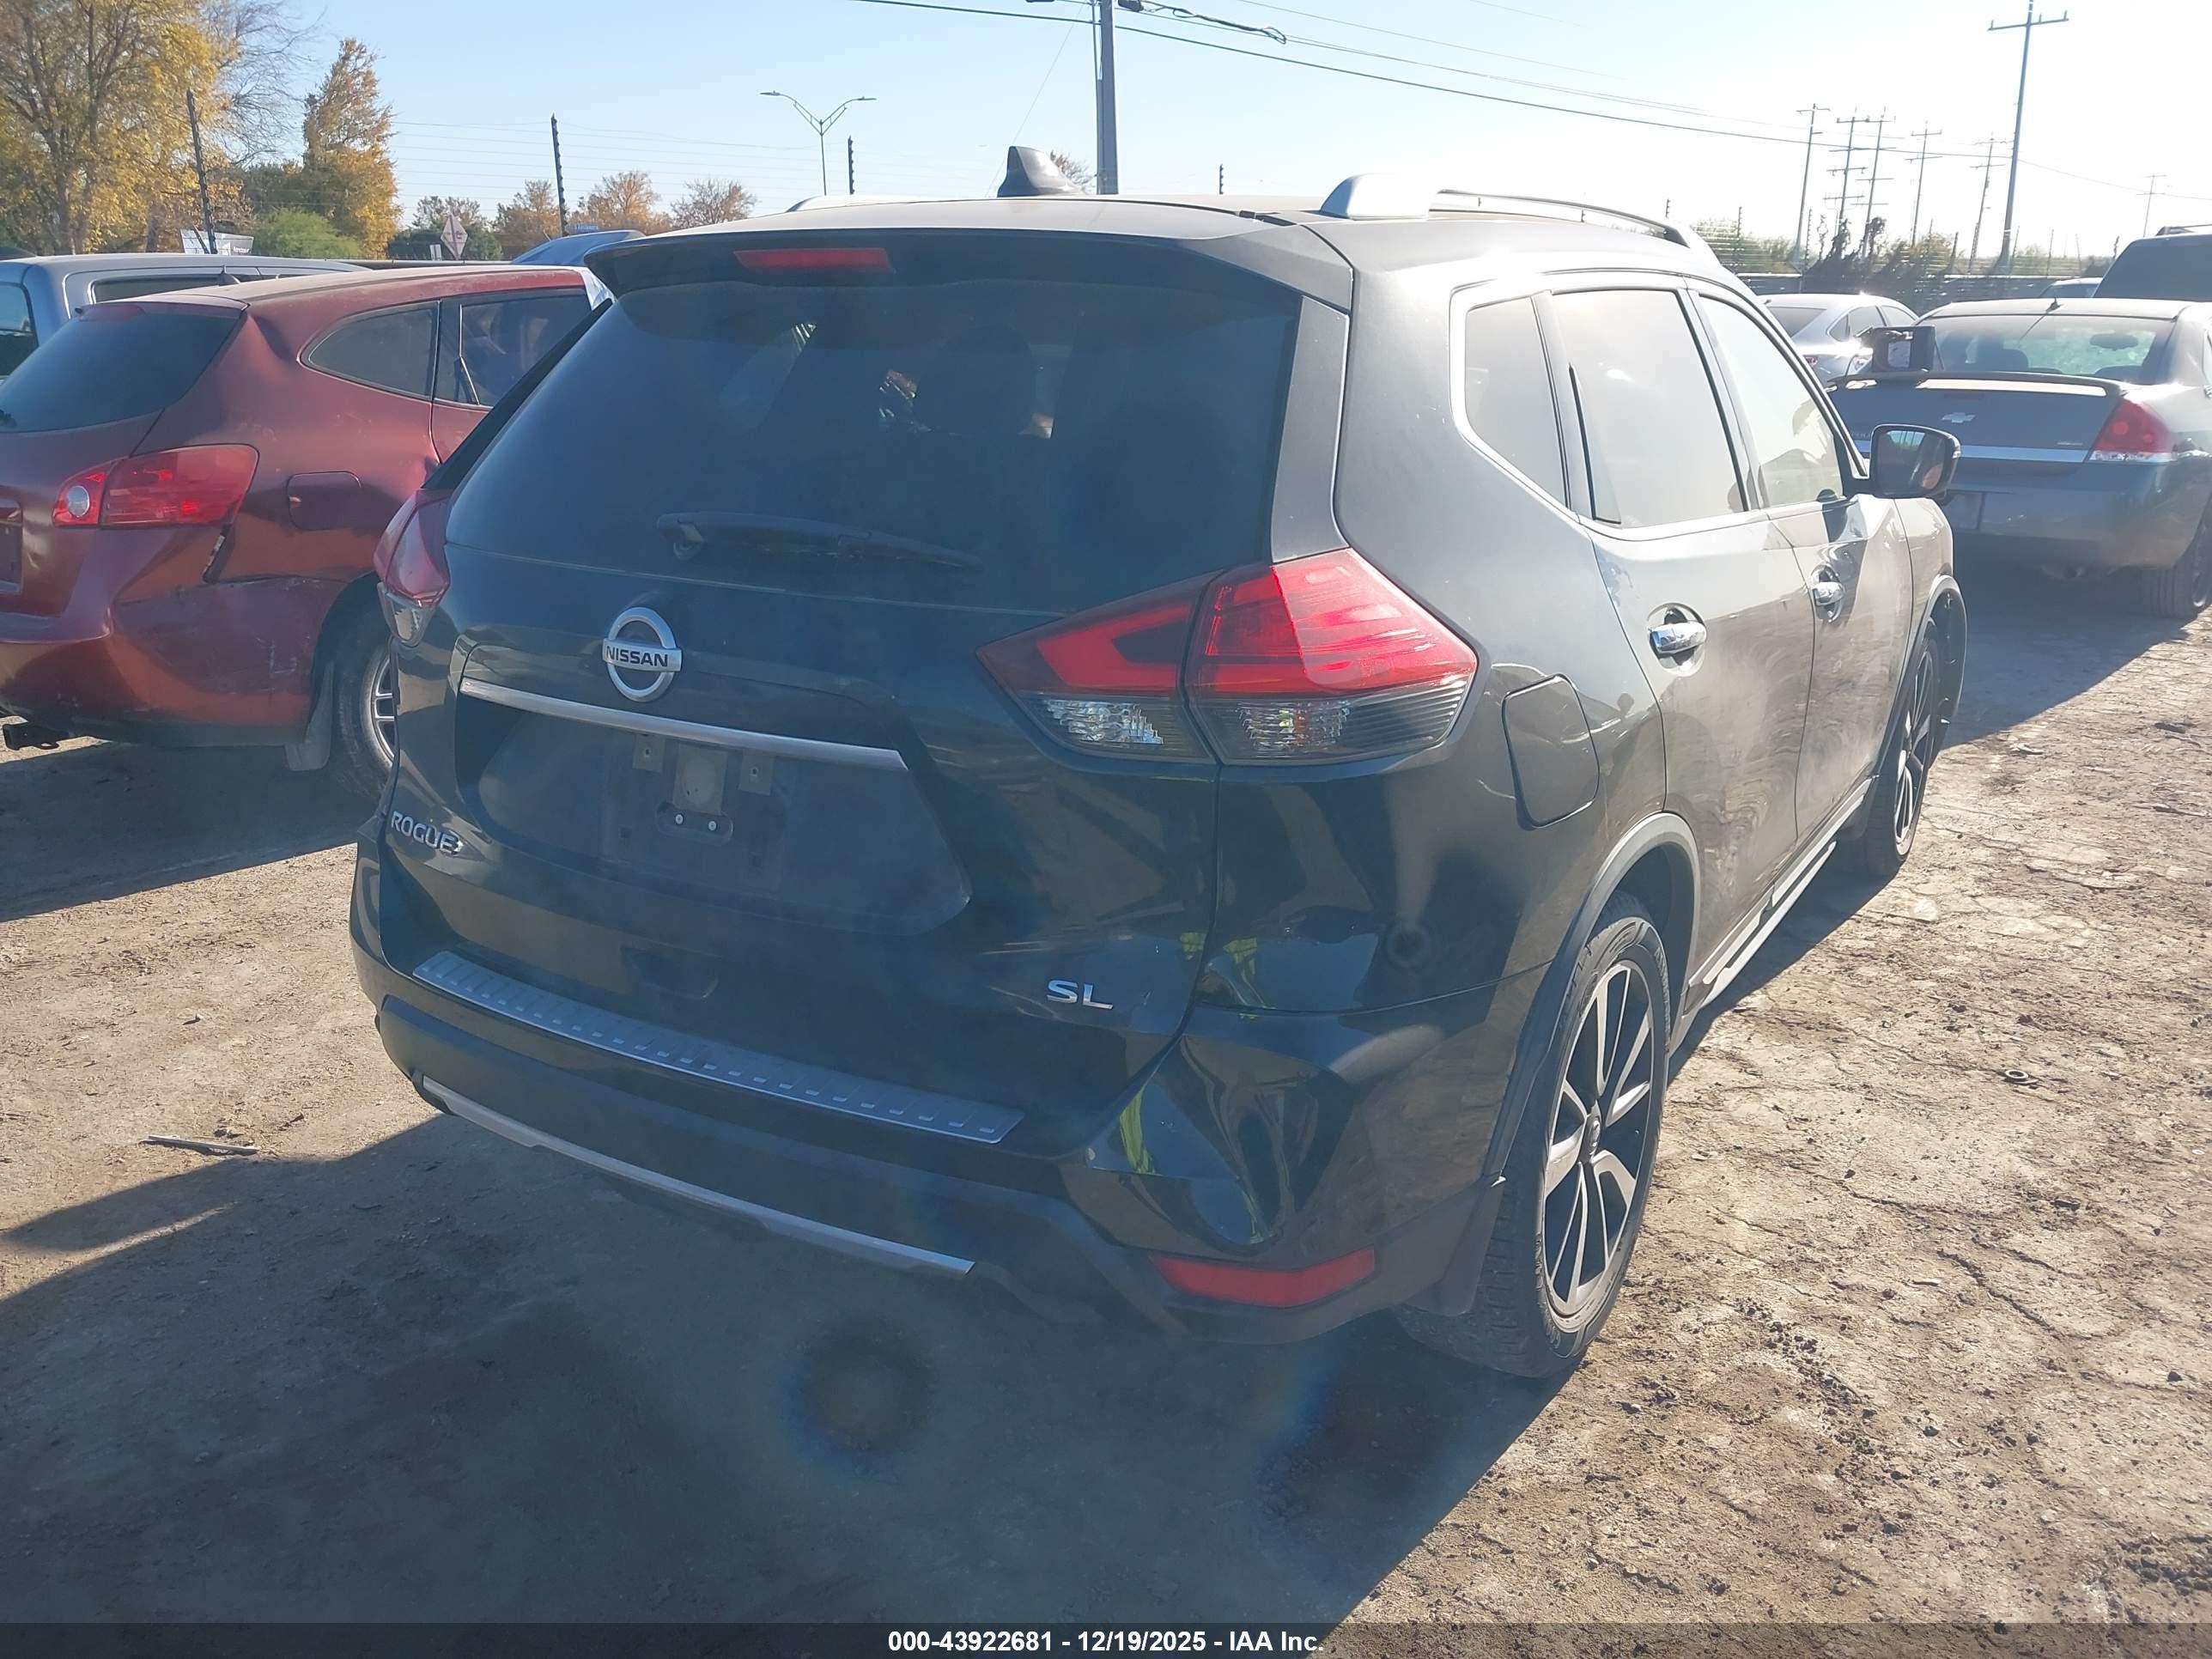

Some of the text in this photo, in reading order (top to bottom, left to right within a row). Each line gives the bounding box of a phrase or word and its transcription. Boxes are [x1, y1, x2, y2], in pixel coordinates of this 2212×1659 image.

[606, 645, 668, 667] NISSAN
[391, 811, 457, 854] ROGUE
[1046, 979, 1114, 1010] SL
